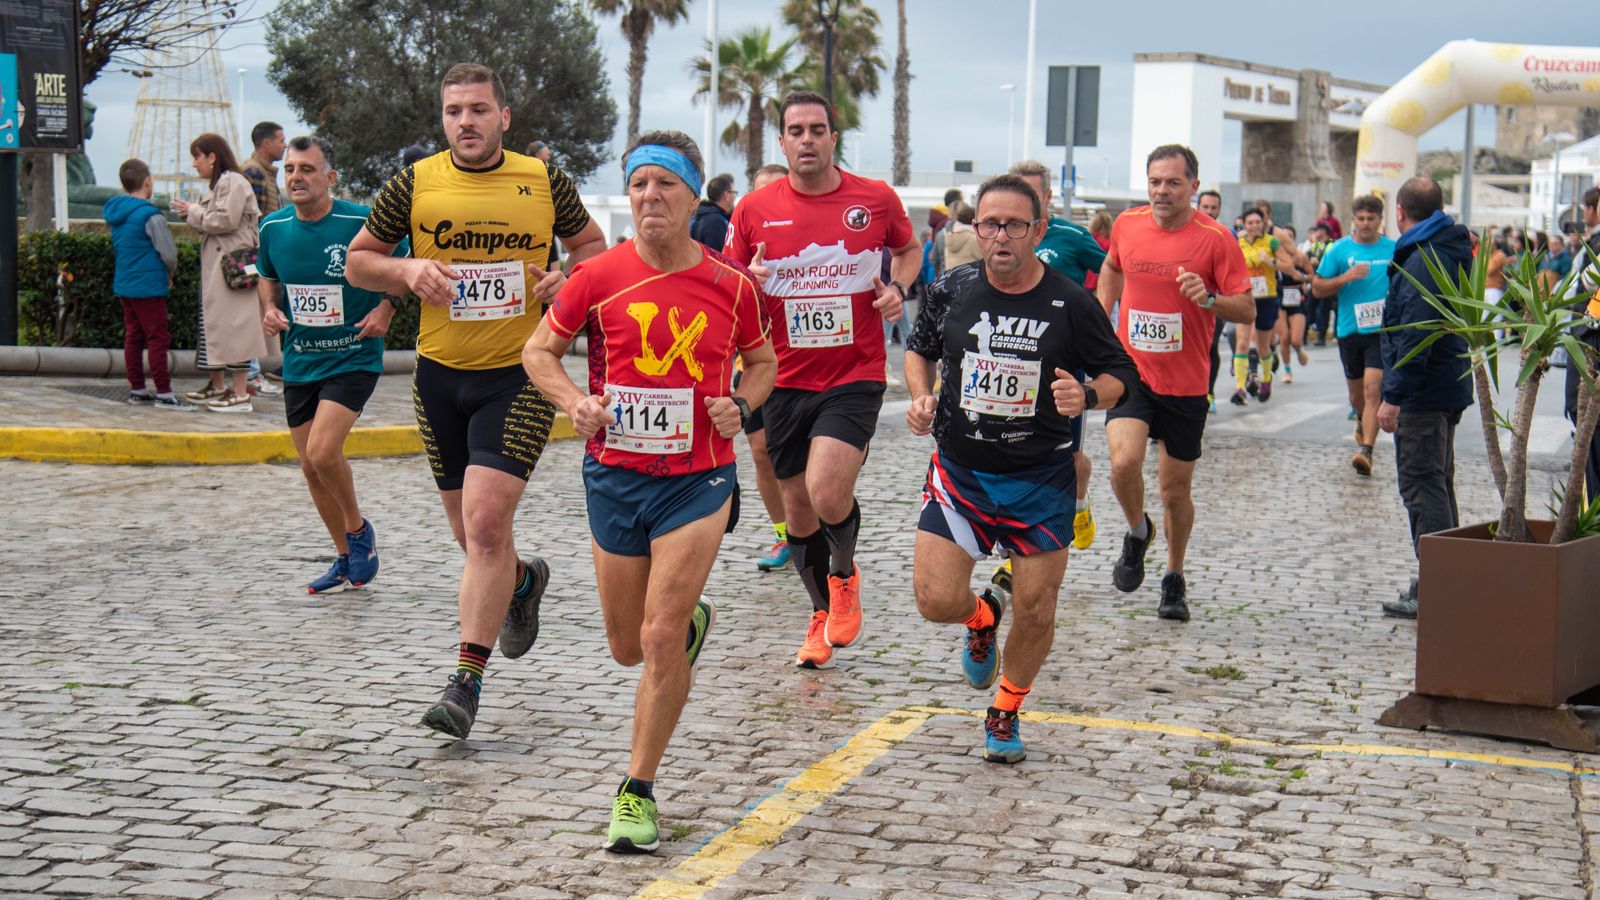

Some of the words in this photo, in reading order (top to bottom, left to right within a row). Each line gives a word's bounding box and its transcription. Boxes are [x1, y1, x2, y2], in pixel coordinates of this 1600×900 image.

[36, 73, 67, 96] ARTE
[420, 220, 546, 254] Campea
[460, 269, 483, 279] XIV
[777, 266, 804, 279] SAN
[809, 264, 858, 278] ROQUE
[467, 279, 505, 301] 478
[792, 280, 838, 290] RUNNING
[300, 296, 327, 312] 295
[795, 303, 814, 311] XIV
[802, 311, 834, 331] 163
[996, 316, 1050, 339] XIV
[1140, 322, 1167, 339] 438
[991, 341, 1038, 352] ESTRECHO
[992, 335, 1034, 345] CARRERA
[976, 358, 999, 372] XIV
[979, 372, 1019, 397] 418
[617, 391, 643, 404] XIV
[625, 405, 669, 431] 114
